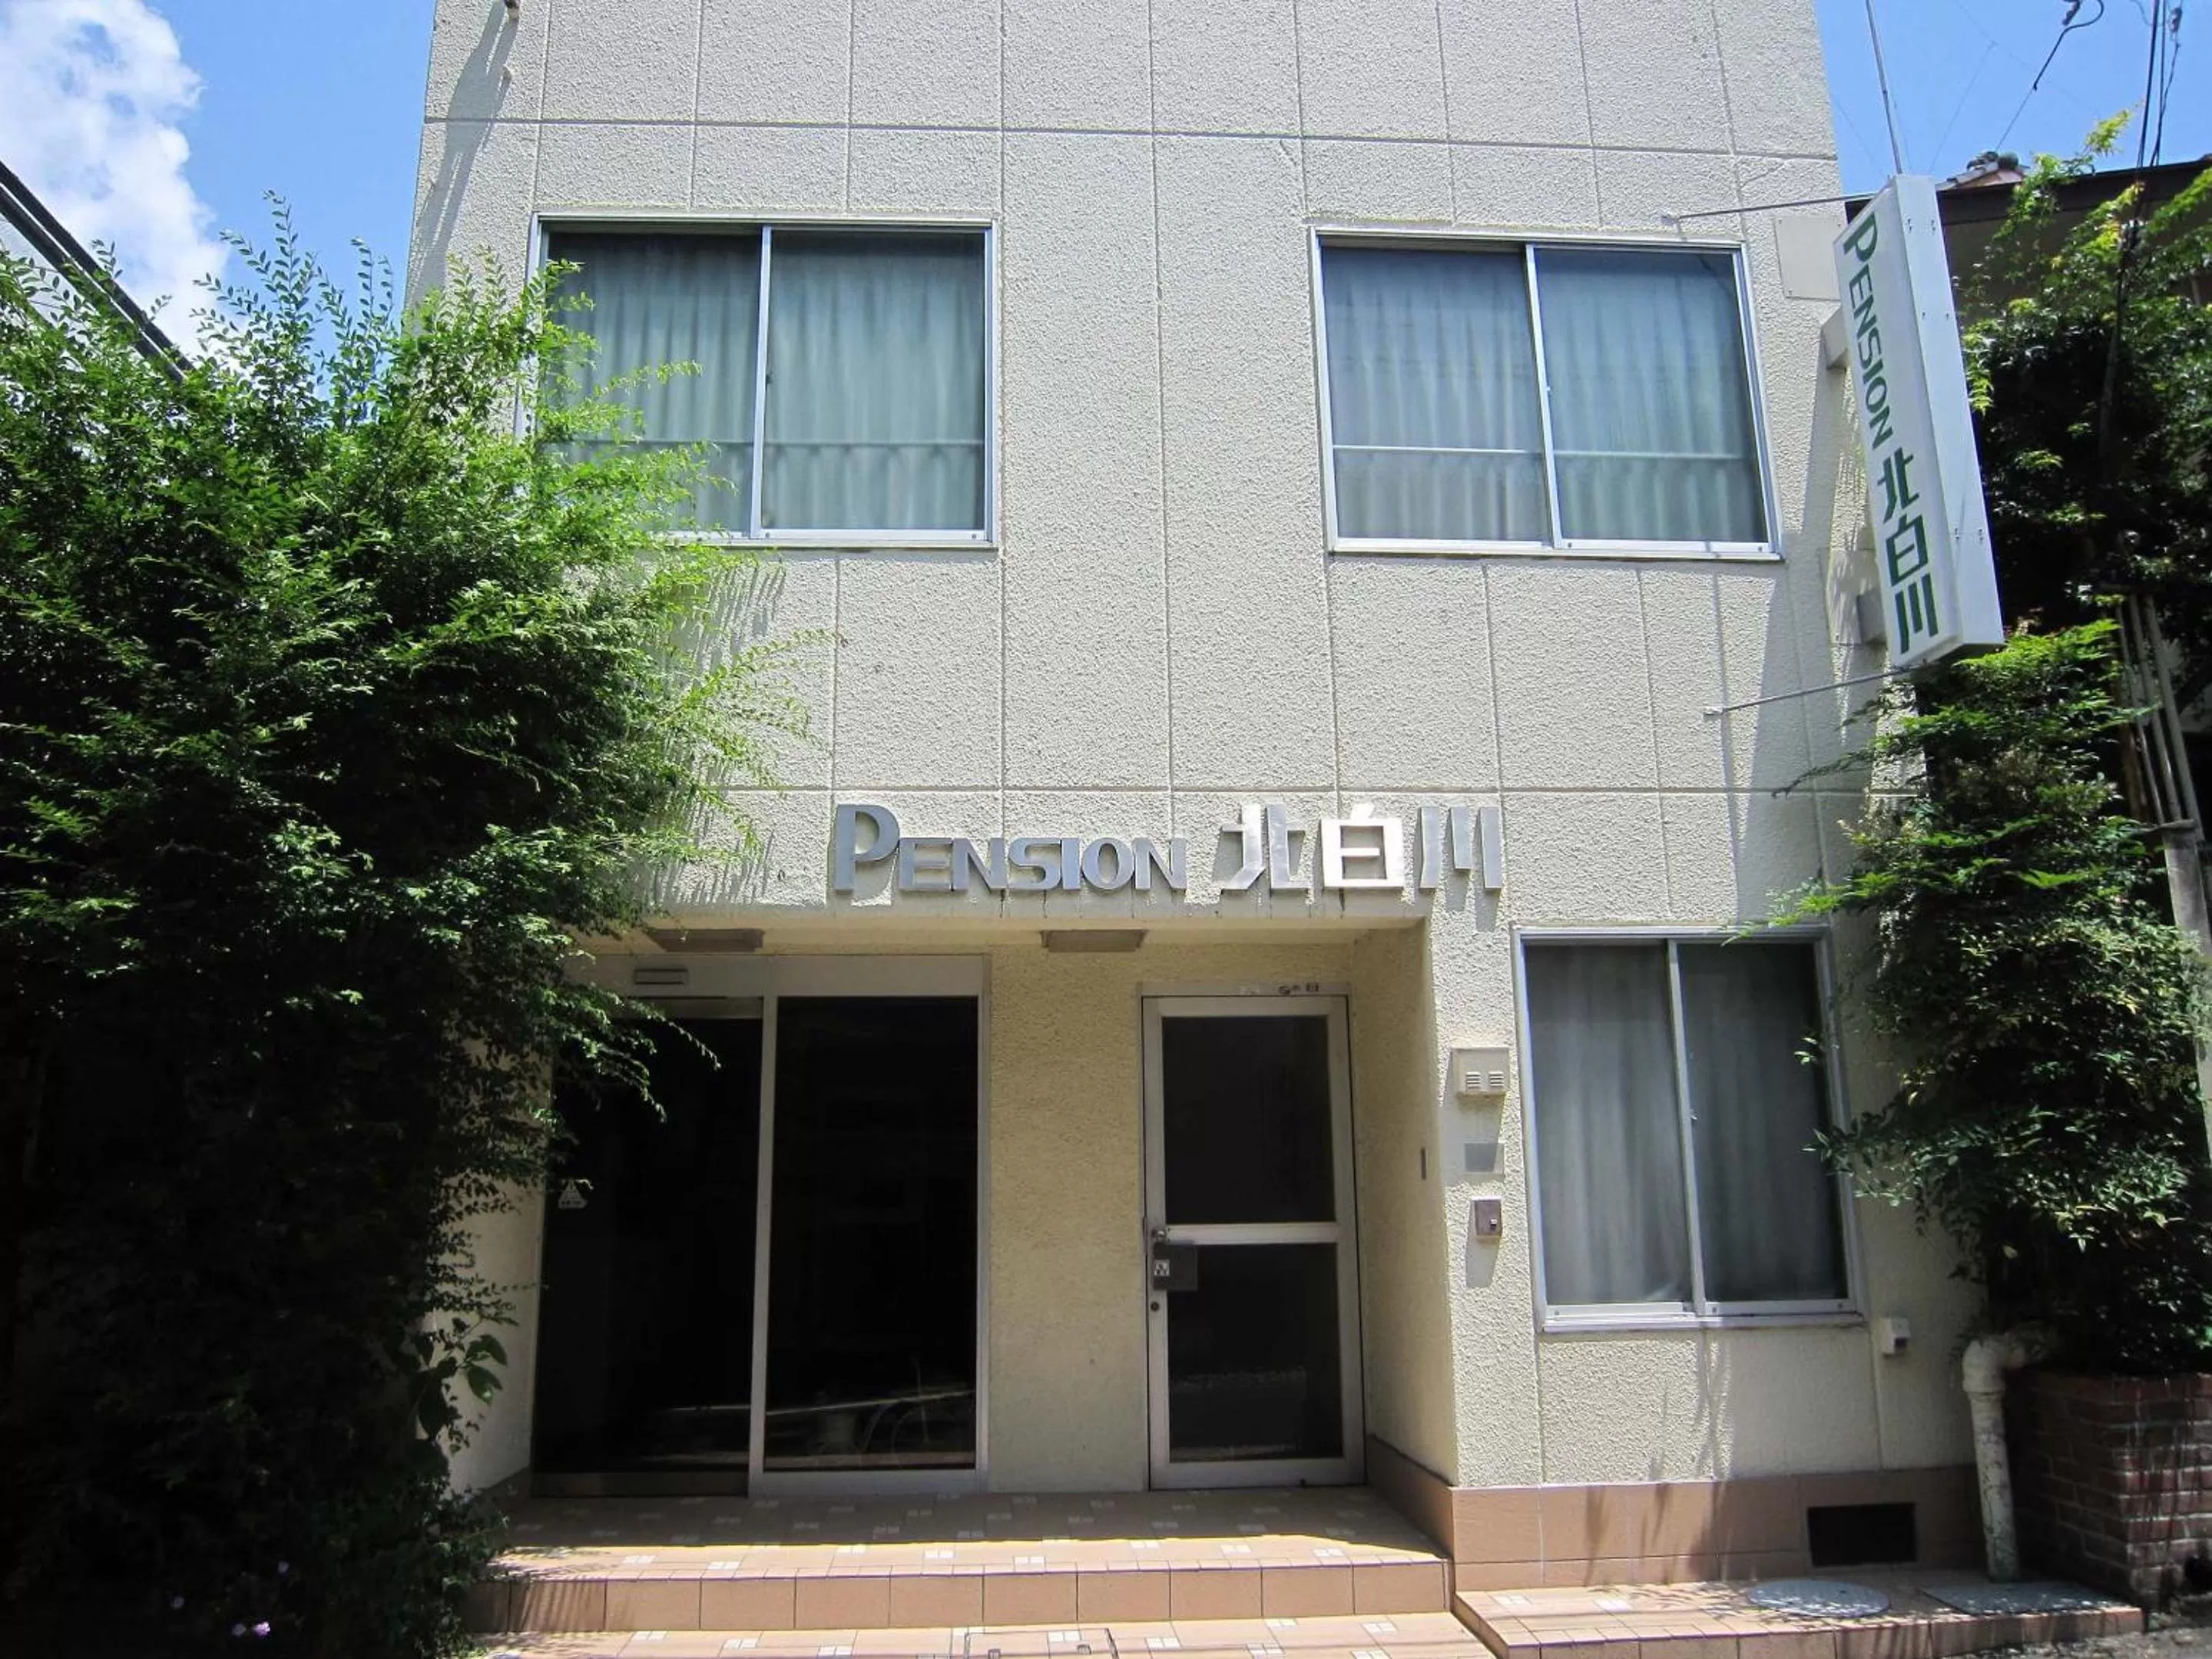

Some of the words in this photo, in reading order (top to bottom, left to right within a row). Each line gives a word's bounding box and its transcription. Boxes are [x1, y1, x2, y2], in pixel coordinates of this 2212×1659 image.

[1844, 212, 1893, 449] PENSION
[1878, 447, 1939, 654] 北白川
[833, 804, 1187, 891] PENSION
[1220, 803, 1503, 889] 北白川
